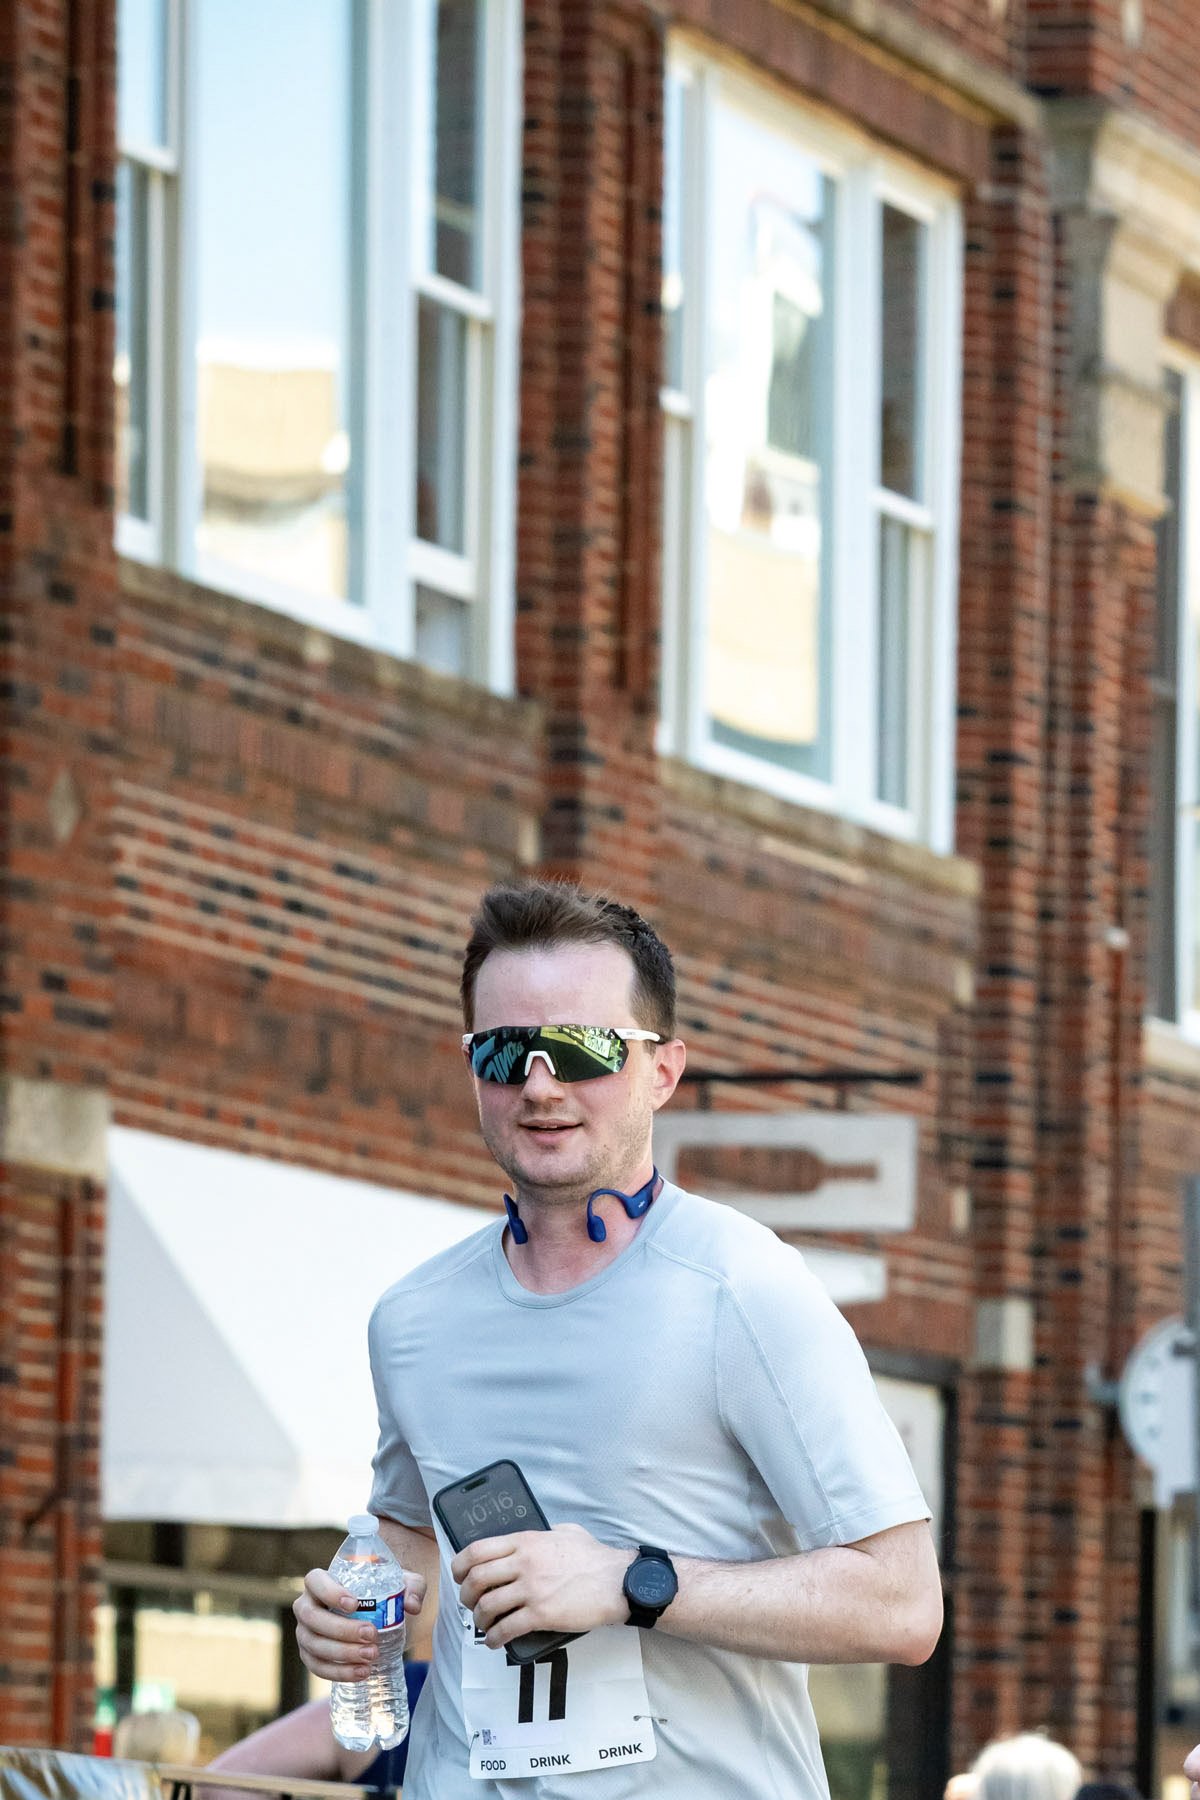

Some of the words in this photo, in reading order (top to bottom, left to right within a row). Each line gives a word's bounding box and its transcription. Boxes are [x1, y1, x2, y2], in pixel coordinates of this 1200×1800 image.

[462, 1490, 514, 1526] 10:16
[506, 1647, 568, 1724] 11
[480, 1760, 507, 1771] FOOD
[529, 1754, 572, 1769] DRINK
[598, 1743, 643, 1760] DRINK
